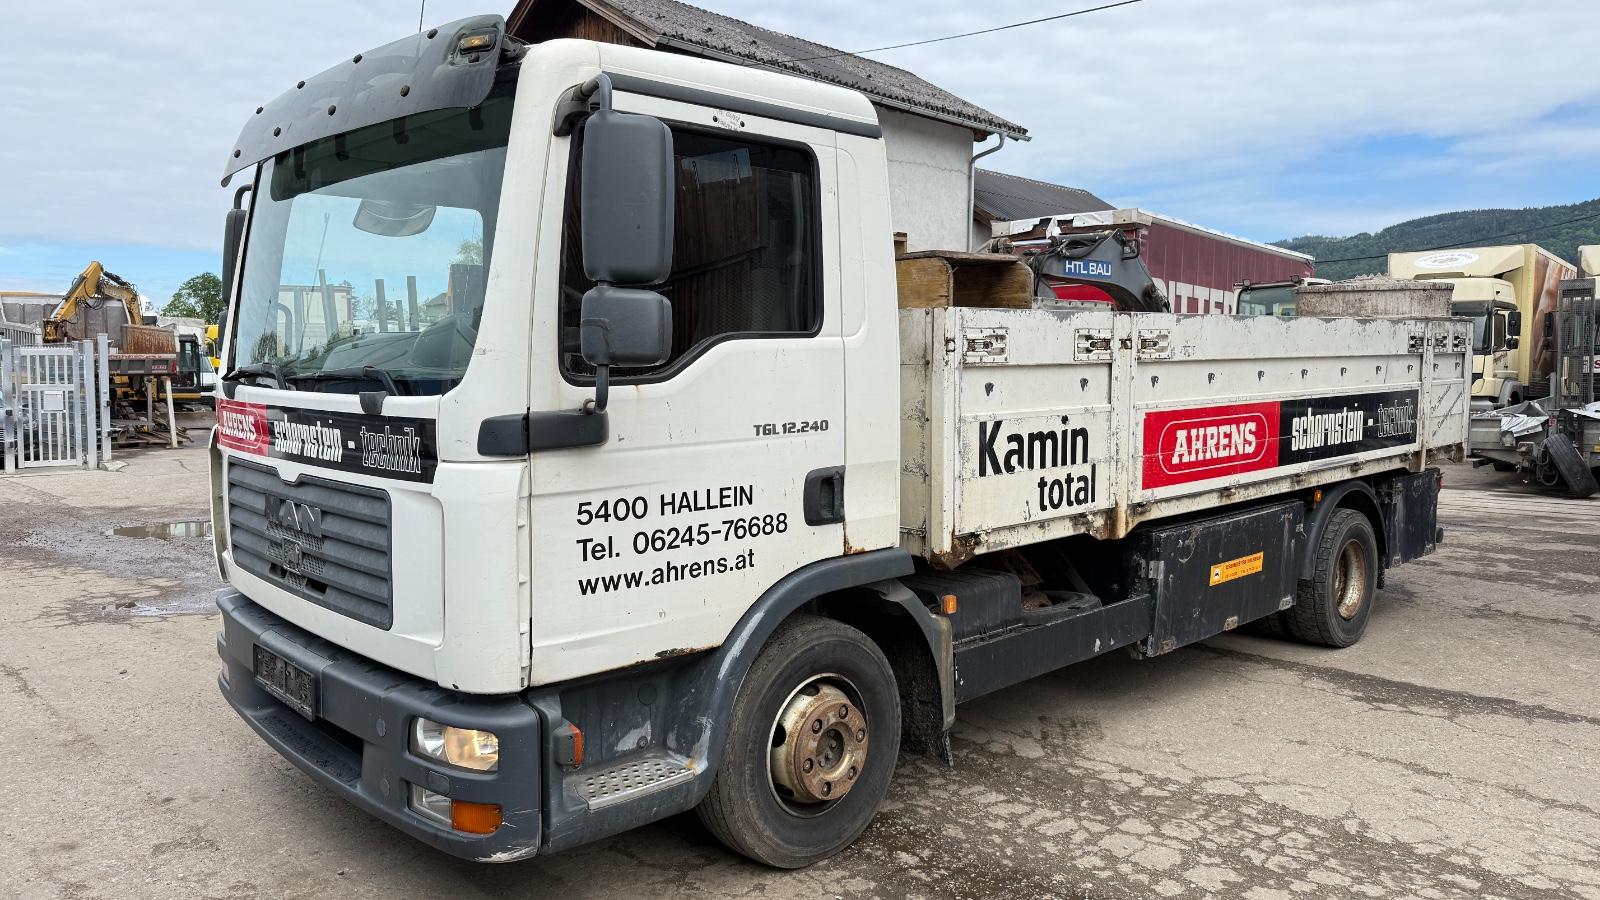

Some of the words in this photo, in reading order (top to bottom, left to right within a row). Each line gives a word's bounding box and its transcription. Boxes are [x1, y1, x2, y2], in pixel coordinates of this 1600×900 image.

[1065, 260, 1088, 275] HTL
[1088, 262, 1112, 276] BAU
[222, 411, 257, 441] AHRENS
[273, 414, 343, 463] schornstein
[360, 426, 421, 474] technik
[753, 424, 780, 437] TGL
[781, 419, 829, 435] 12.240
[978, 414, 1089, 478] Kamin
[1171, 421, 1257, 465] AHRENS
[1291, 402, 1364, 452] schornstein
[1378, 398, 1414, 440] technik
[576, 495, 649, 526] 5400
[659, 484, 754, 517] HALLEIN
[1037, 462, 1097, 512] total
[264, 493, 323, 538] MAN
[576, 535, 621, 563] Tel.
[632, 512, 788, 555] 06245-76688
[577, 548, 756, 596] www.ahrens.at
